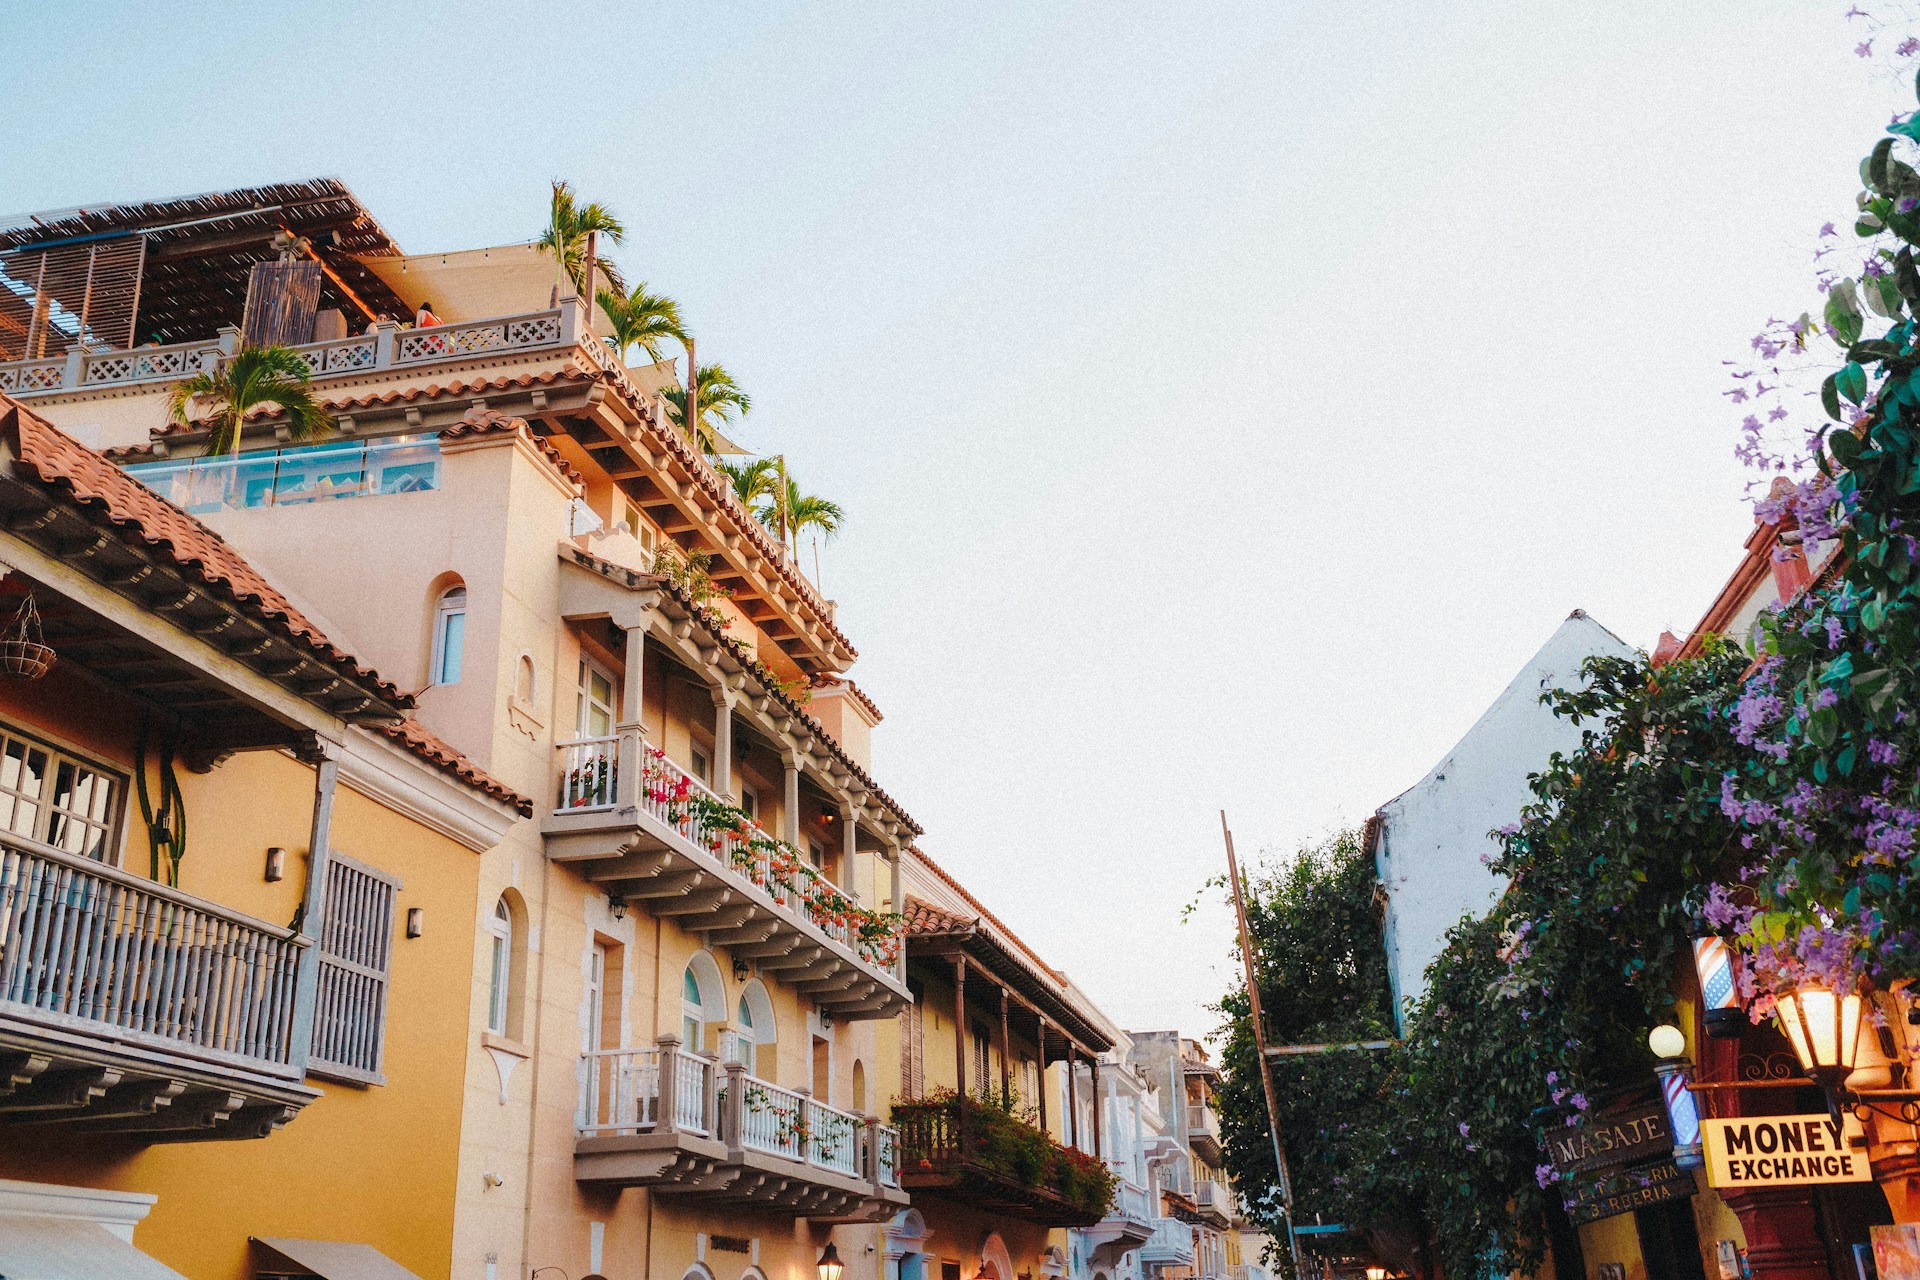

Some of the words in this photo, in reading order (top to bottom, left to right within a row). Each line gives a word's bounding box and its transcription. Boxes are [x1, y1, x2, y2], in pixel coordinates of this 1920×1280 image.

[1556, 1115, 1665, 1162] MASAJE
[1723, 1121, 1843, 1156] MONEY
[1728, 1155, 1854, 1180] EXCHANGE
[1590, 1184, 1671, 1217] BRBERIA
